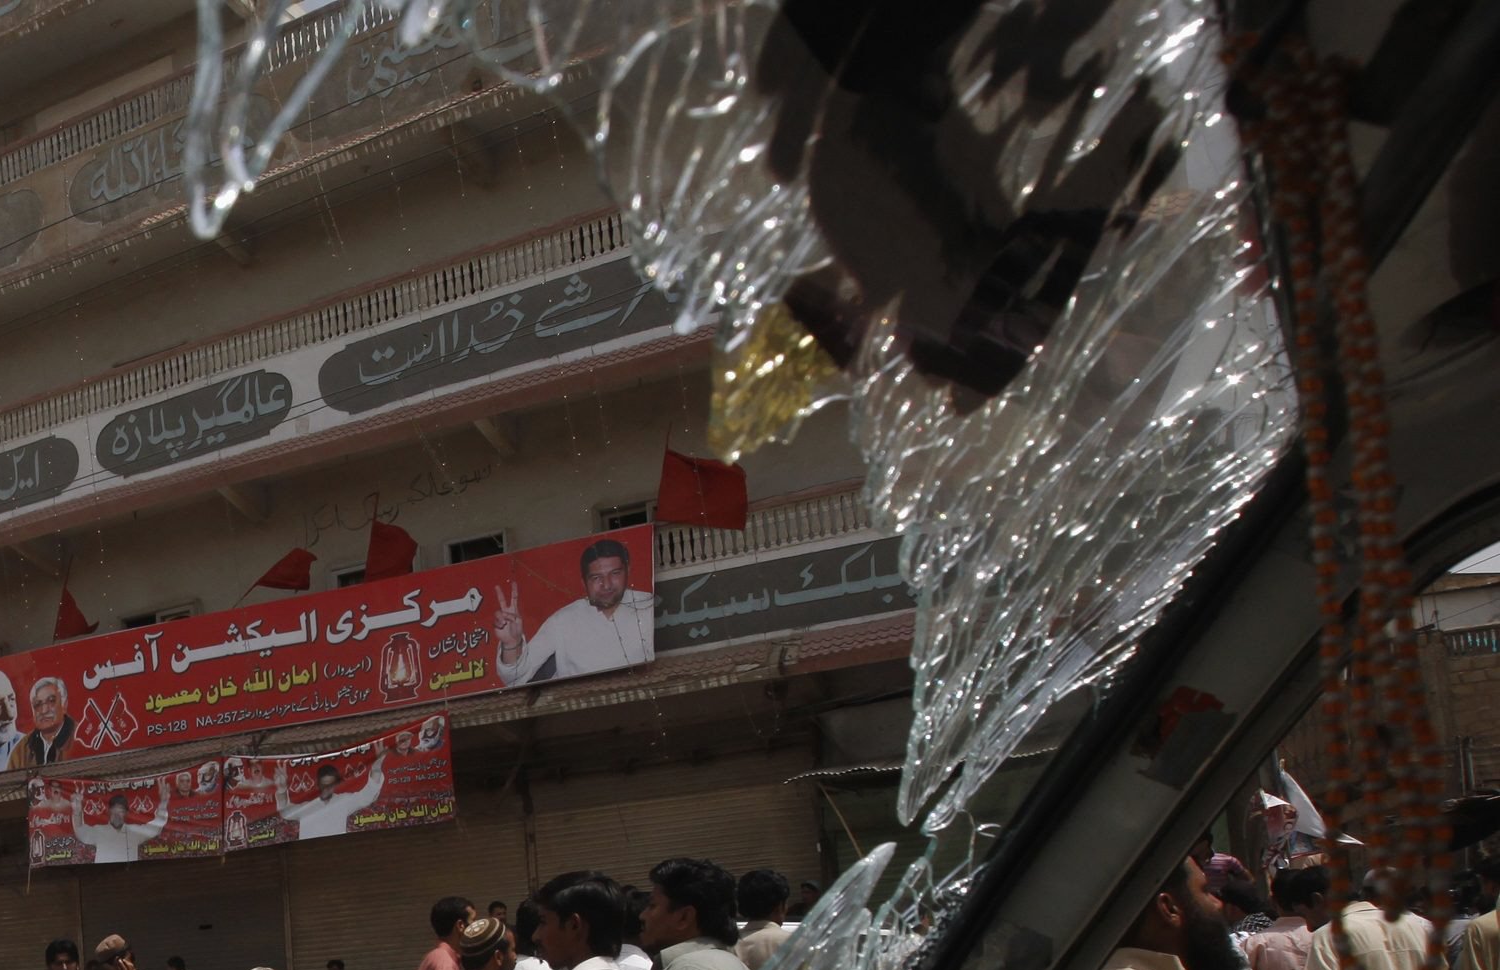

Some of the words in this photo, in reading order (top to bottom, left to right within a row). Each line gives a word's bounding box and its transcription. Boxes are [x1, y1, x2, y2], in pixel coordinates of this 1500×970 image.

[187, 376, 286, 450] عالمگیر
[112, 407, 185, 462] پلازہ
[325, 586, 484, 646] مرکزی
[170, 608, 319, 673] الیکشن
[428, 633, 457, 659] نشان
[456, 628, 490, 657] انتخابی
[82, 629, 164, 690] آفس
[428, 658, 485, 691] لالٹین
[206, 676, 238, 704] خان
[278, 660, 318, 692] امان
[147, 719, 188, 736] PS-128
[196, 710, 238, 728] NA-257
